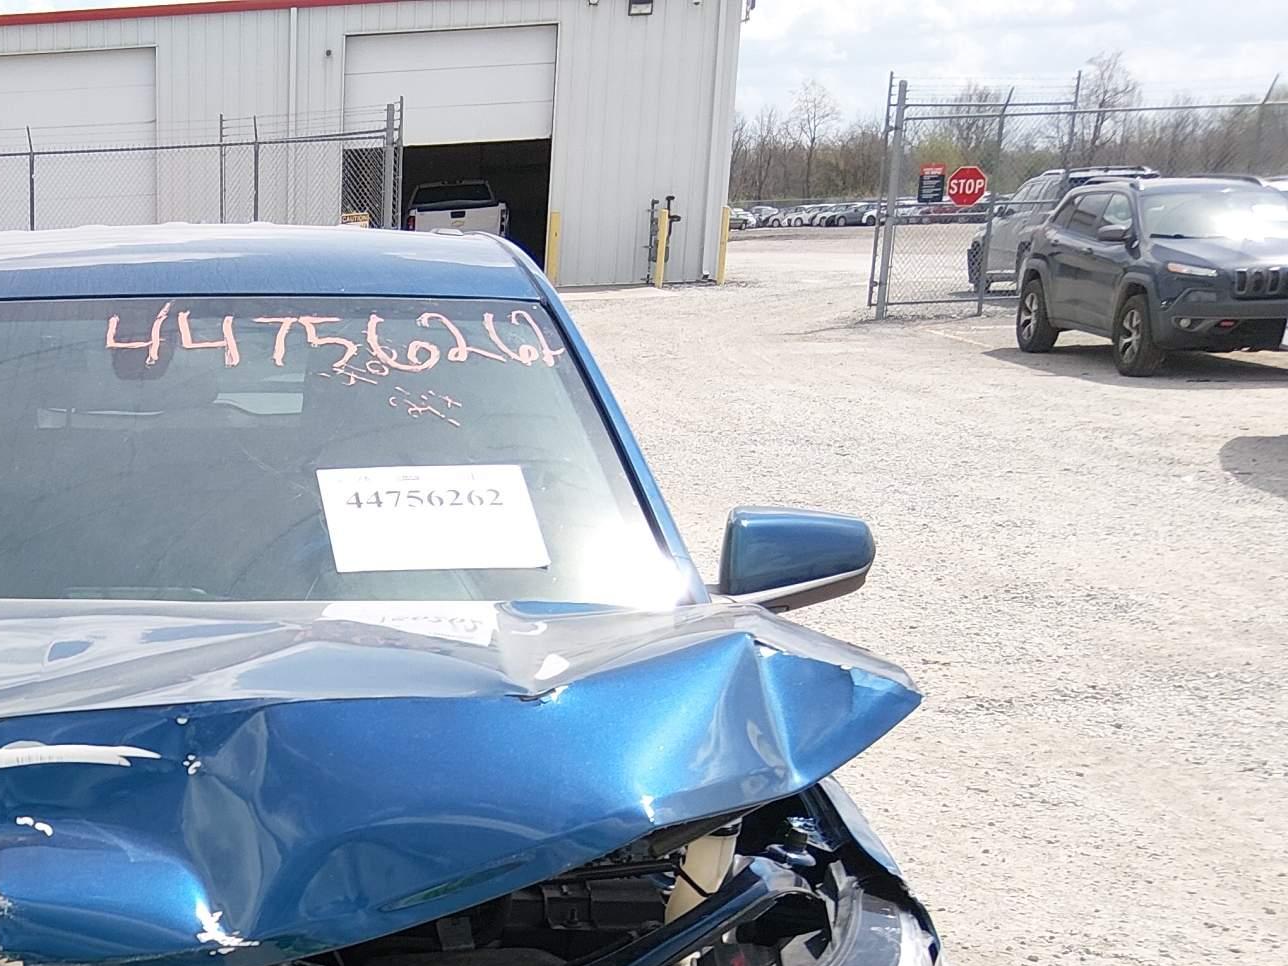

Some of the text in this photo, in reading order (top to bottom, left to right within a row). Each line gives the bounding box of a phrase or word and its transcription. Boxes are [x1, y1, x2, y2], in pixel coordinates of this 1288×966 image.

[949, 179, 984, 194] STOP
[106, 300, 565, 370] 44756262
[346, 488, 504, 508] 44756262
